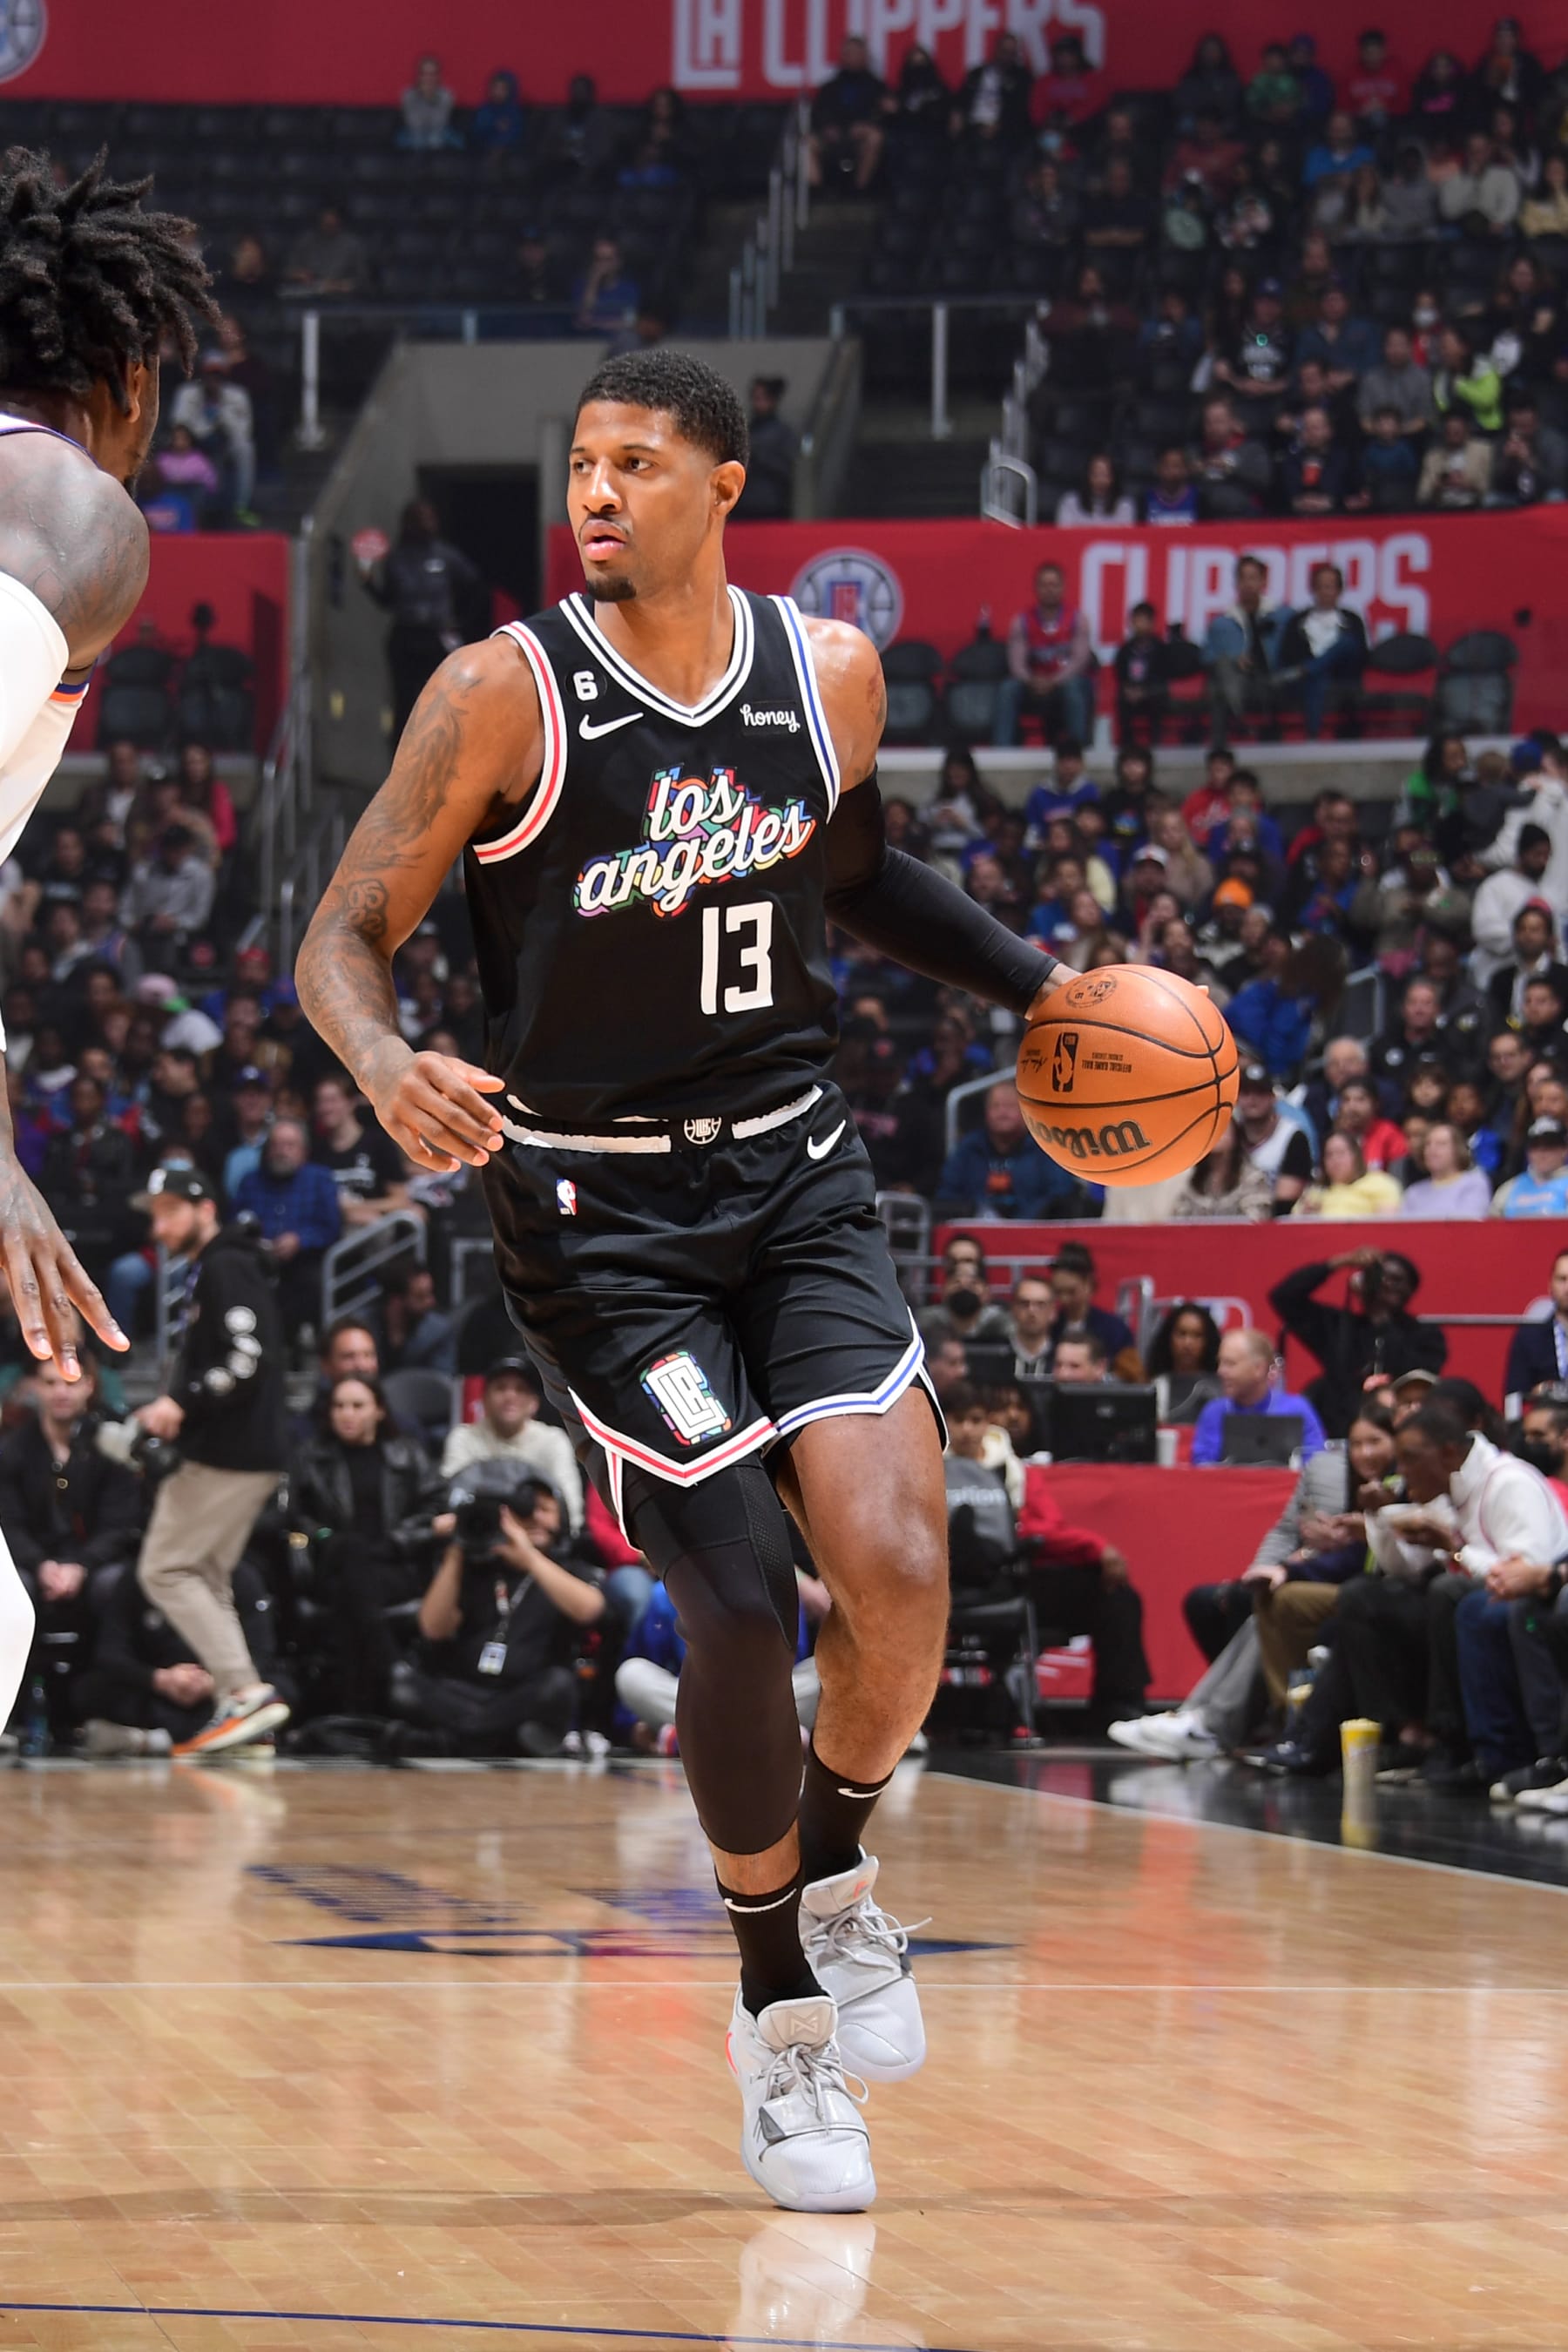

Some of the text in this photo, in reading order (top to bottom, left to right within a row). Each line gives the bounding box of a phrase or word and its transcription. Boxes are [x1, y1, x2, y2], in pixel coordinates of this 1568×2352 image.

[572, 670, 599, 701] 6
[740, 703, 801, 733] honey
[646, 767, 746, 841] los
[575, 800, 816, 915] angeles
[700, 901, 774, 1015] 13
